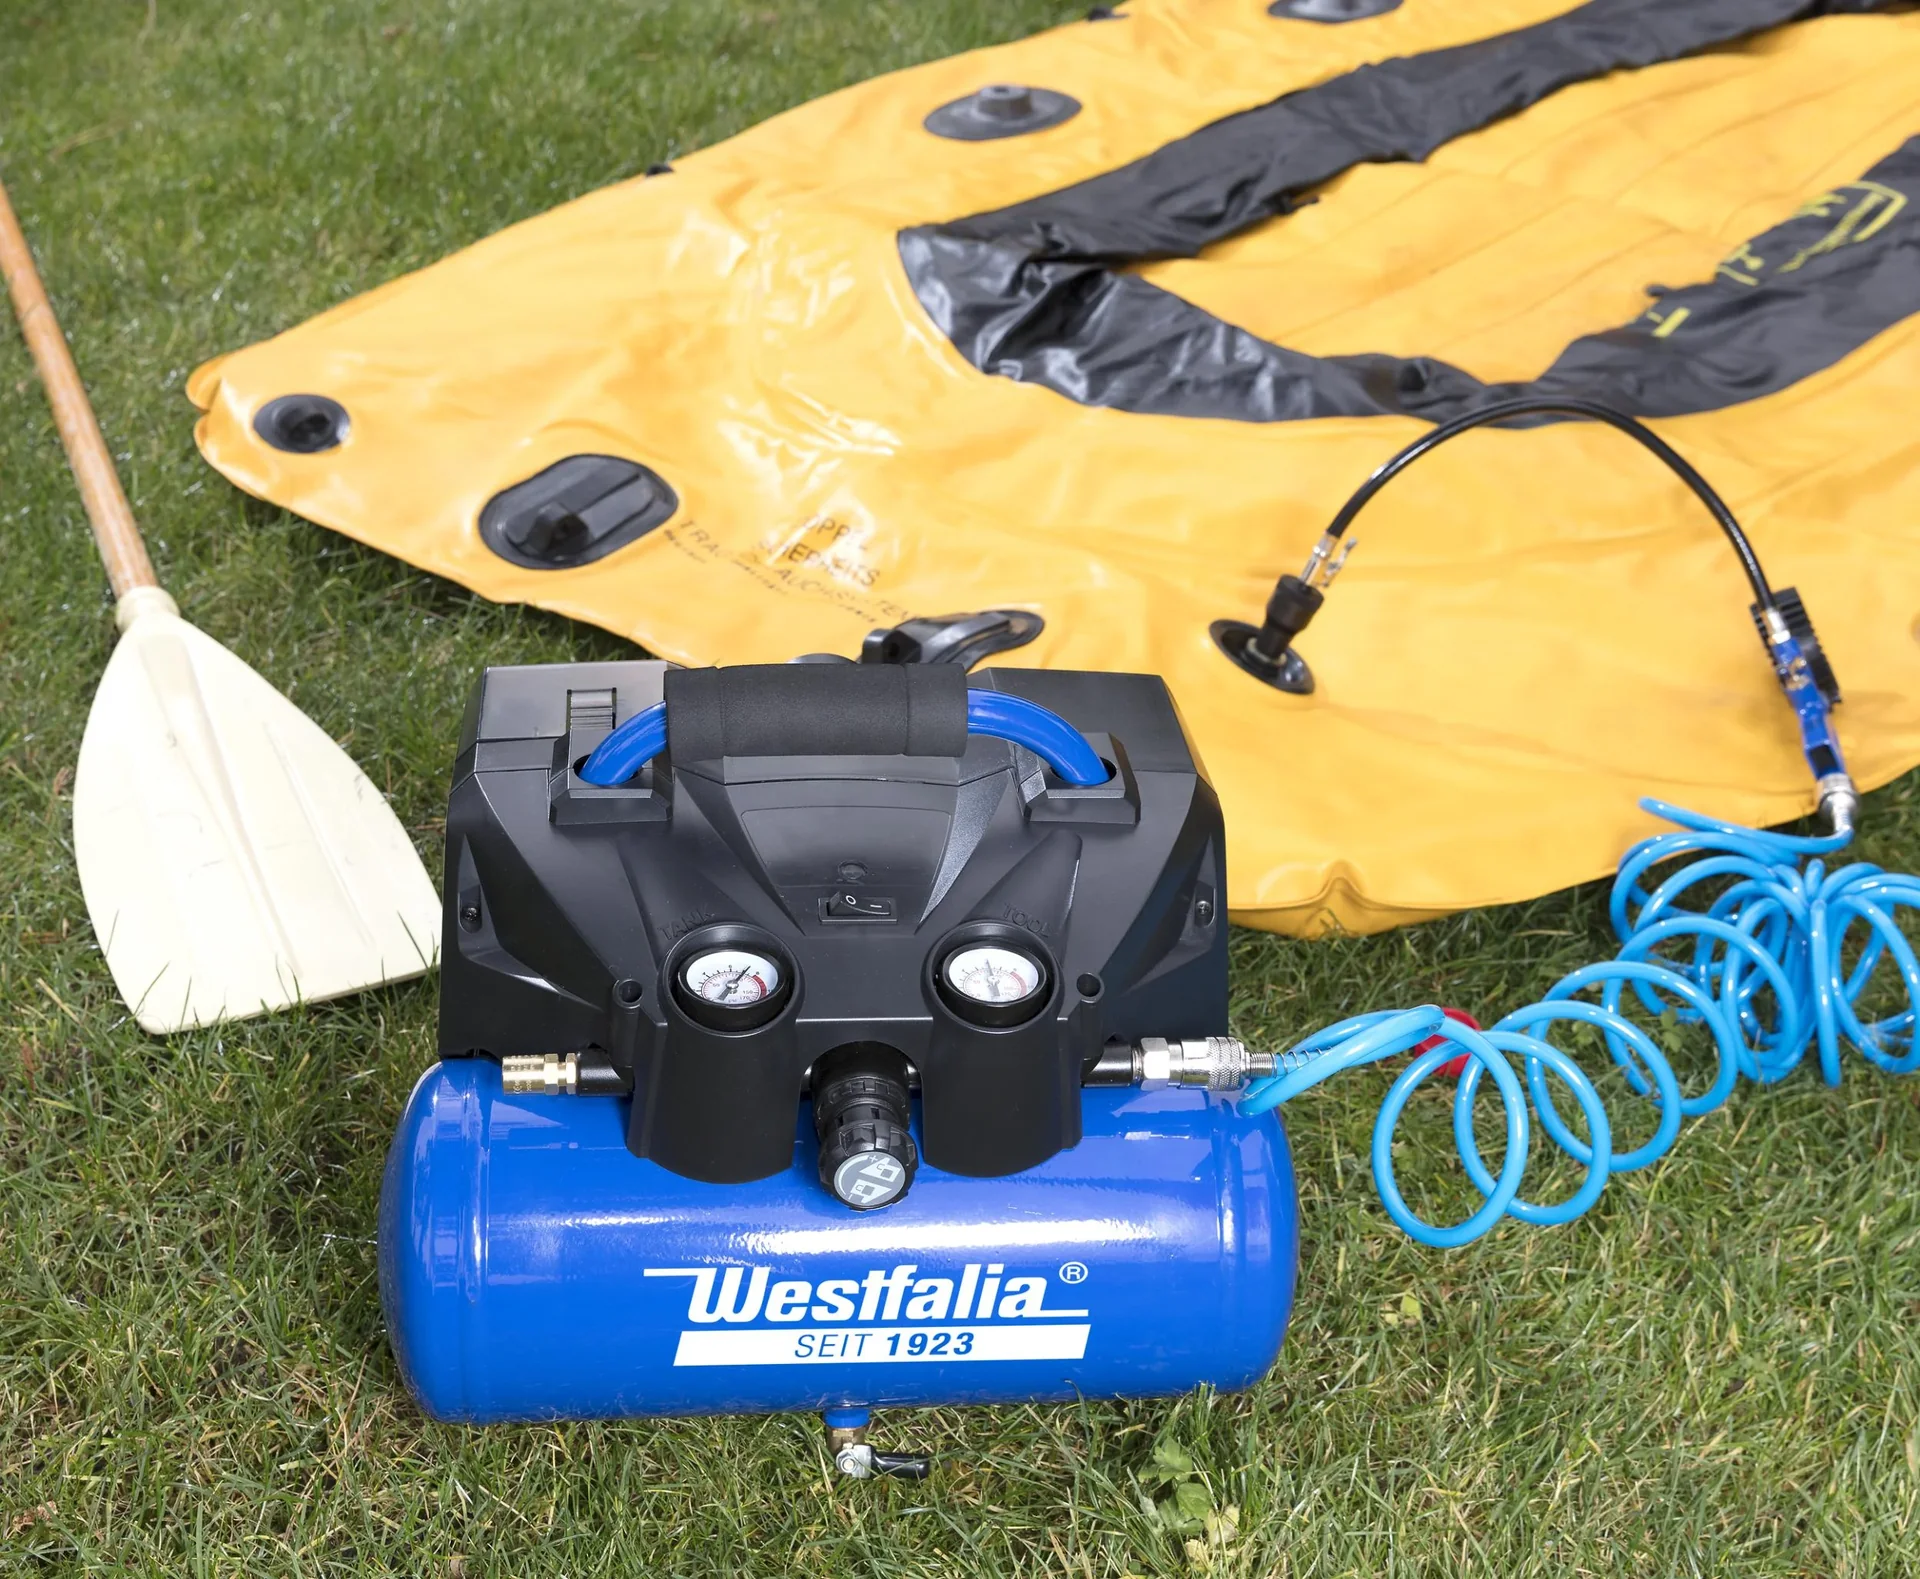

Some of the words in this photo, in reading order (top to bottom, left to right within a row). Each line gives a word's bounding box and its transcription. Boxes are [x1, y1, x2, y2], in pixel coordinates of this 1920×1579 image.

[644, 1263, 1088, 1324] Westfalia
[794, 1333, 874, 1358] SEIT
[886, 1331, 975, 1357] 1923
